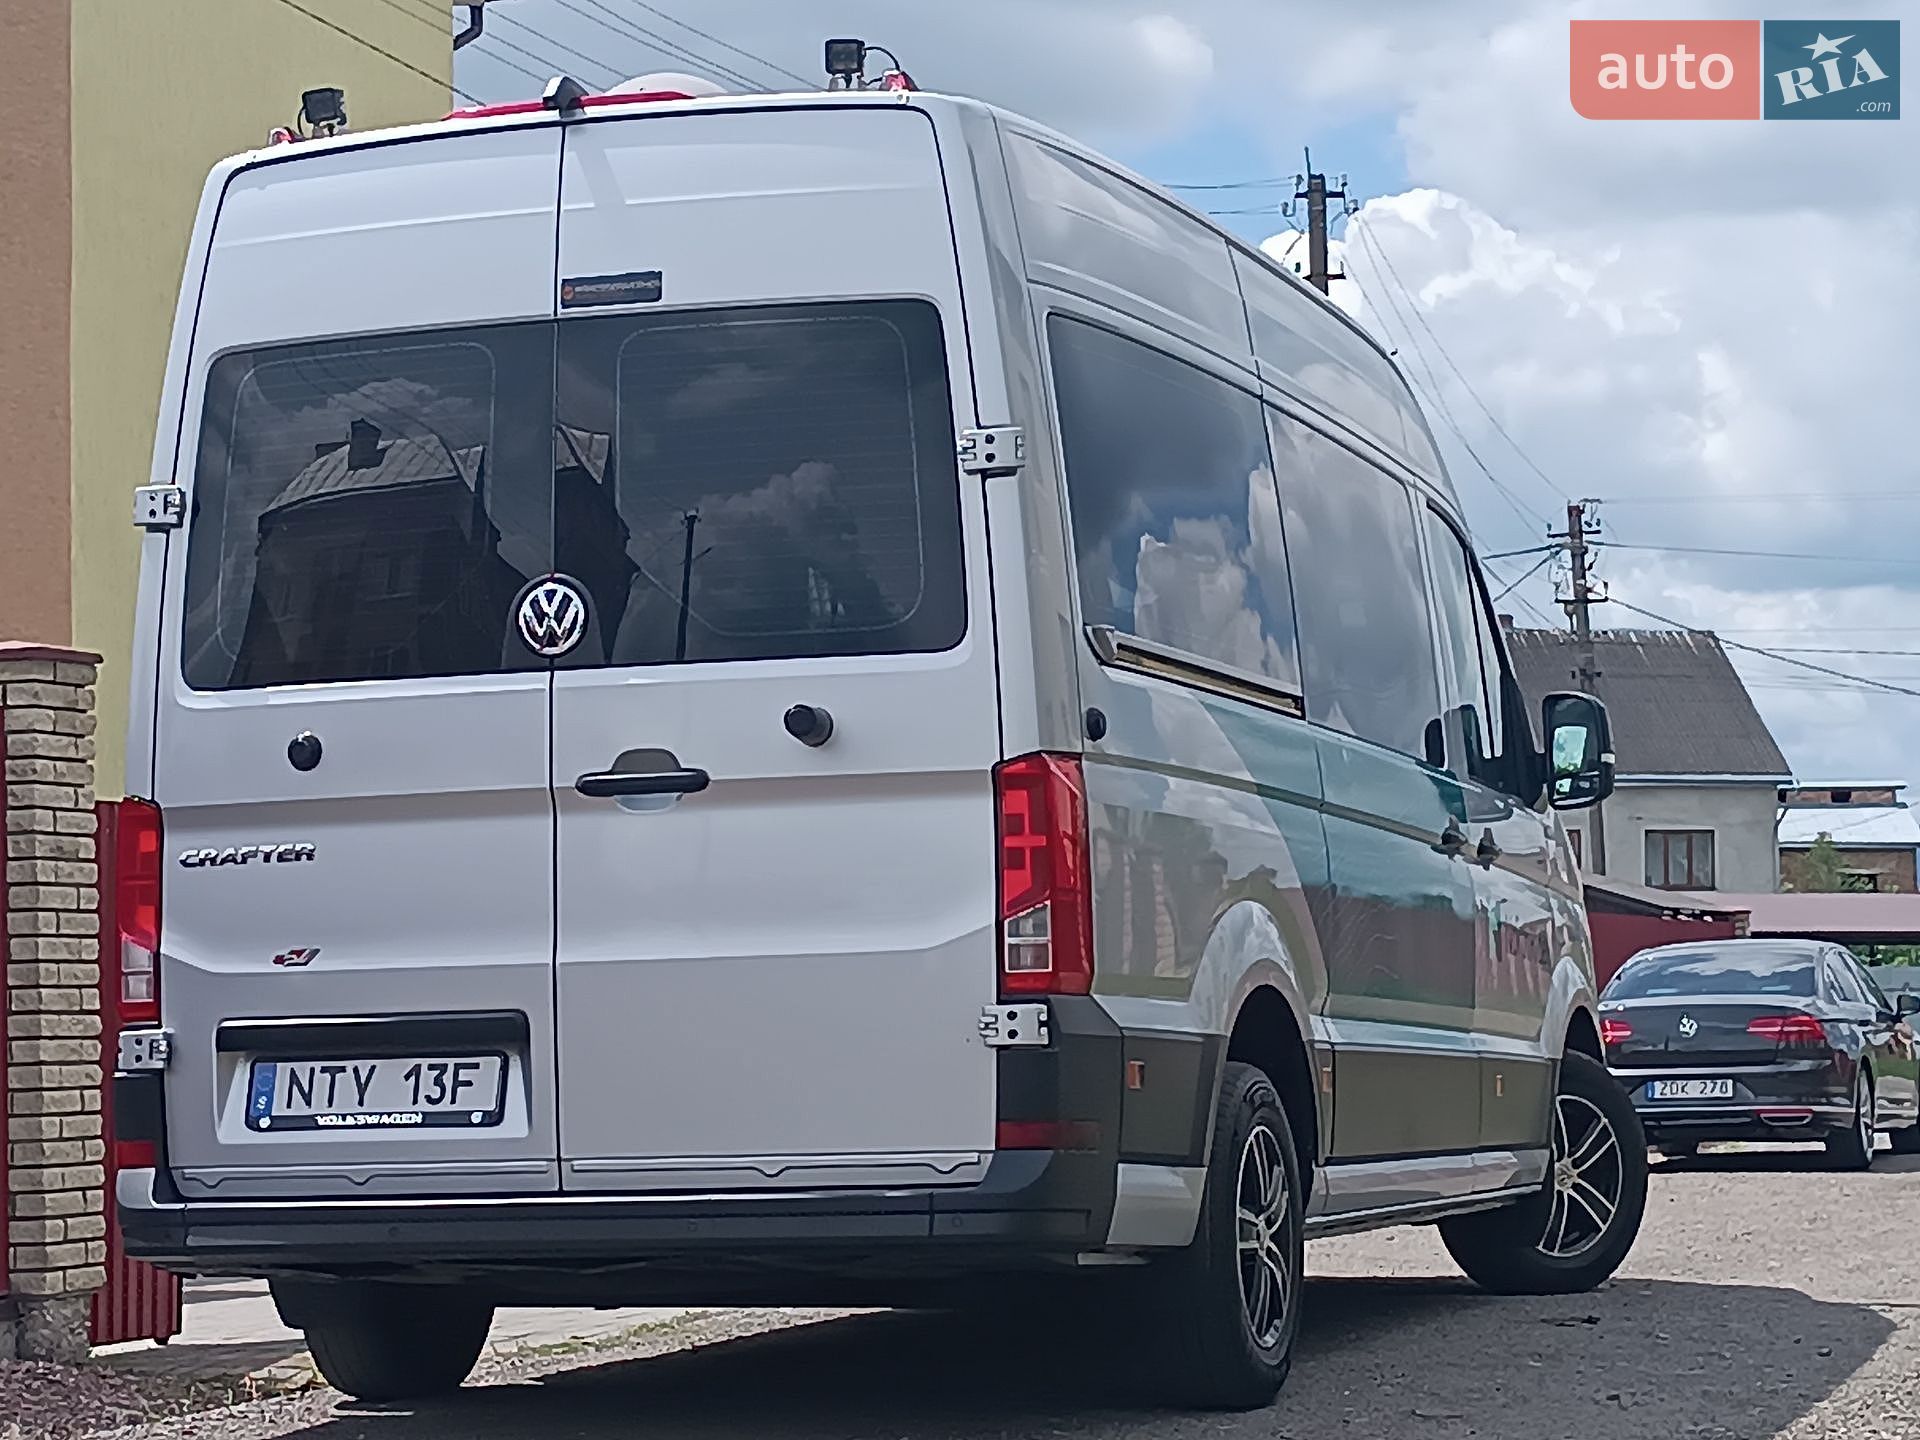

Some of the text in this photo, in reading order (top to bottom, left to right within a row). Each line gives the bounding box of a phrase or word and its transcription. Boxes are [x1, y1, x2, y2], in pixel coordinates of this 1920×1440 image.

[179, 842, 317, 869] CRAFTER
[286, 1062, 480, 1109] NTY 13F
